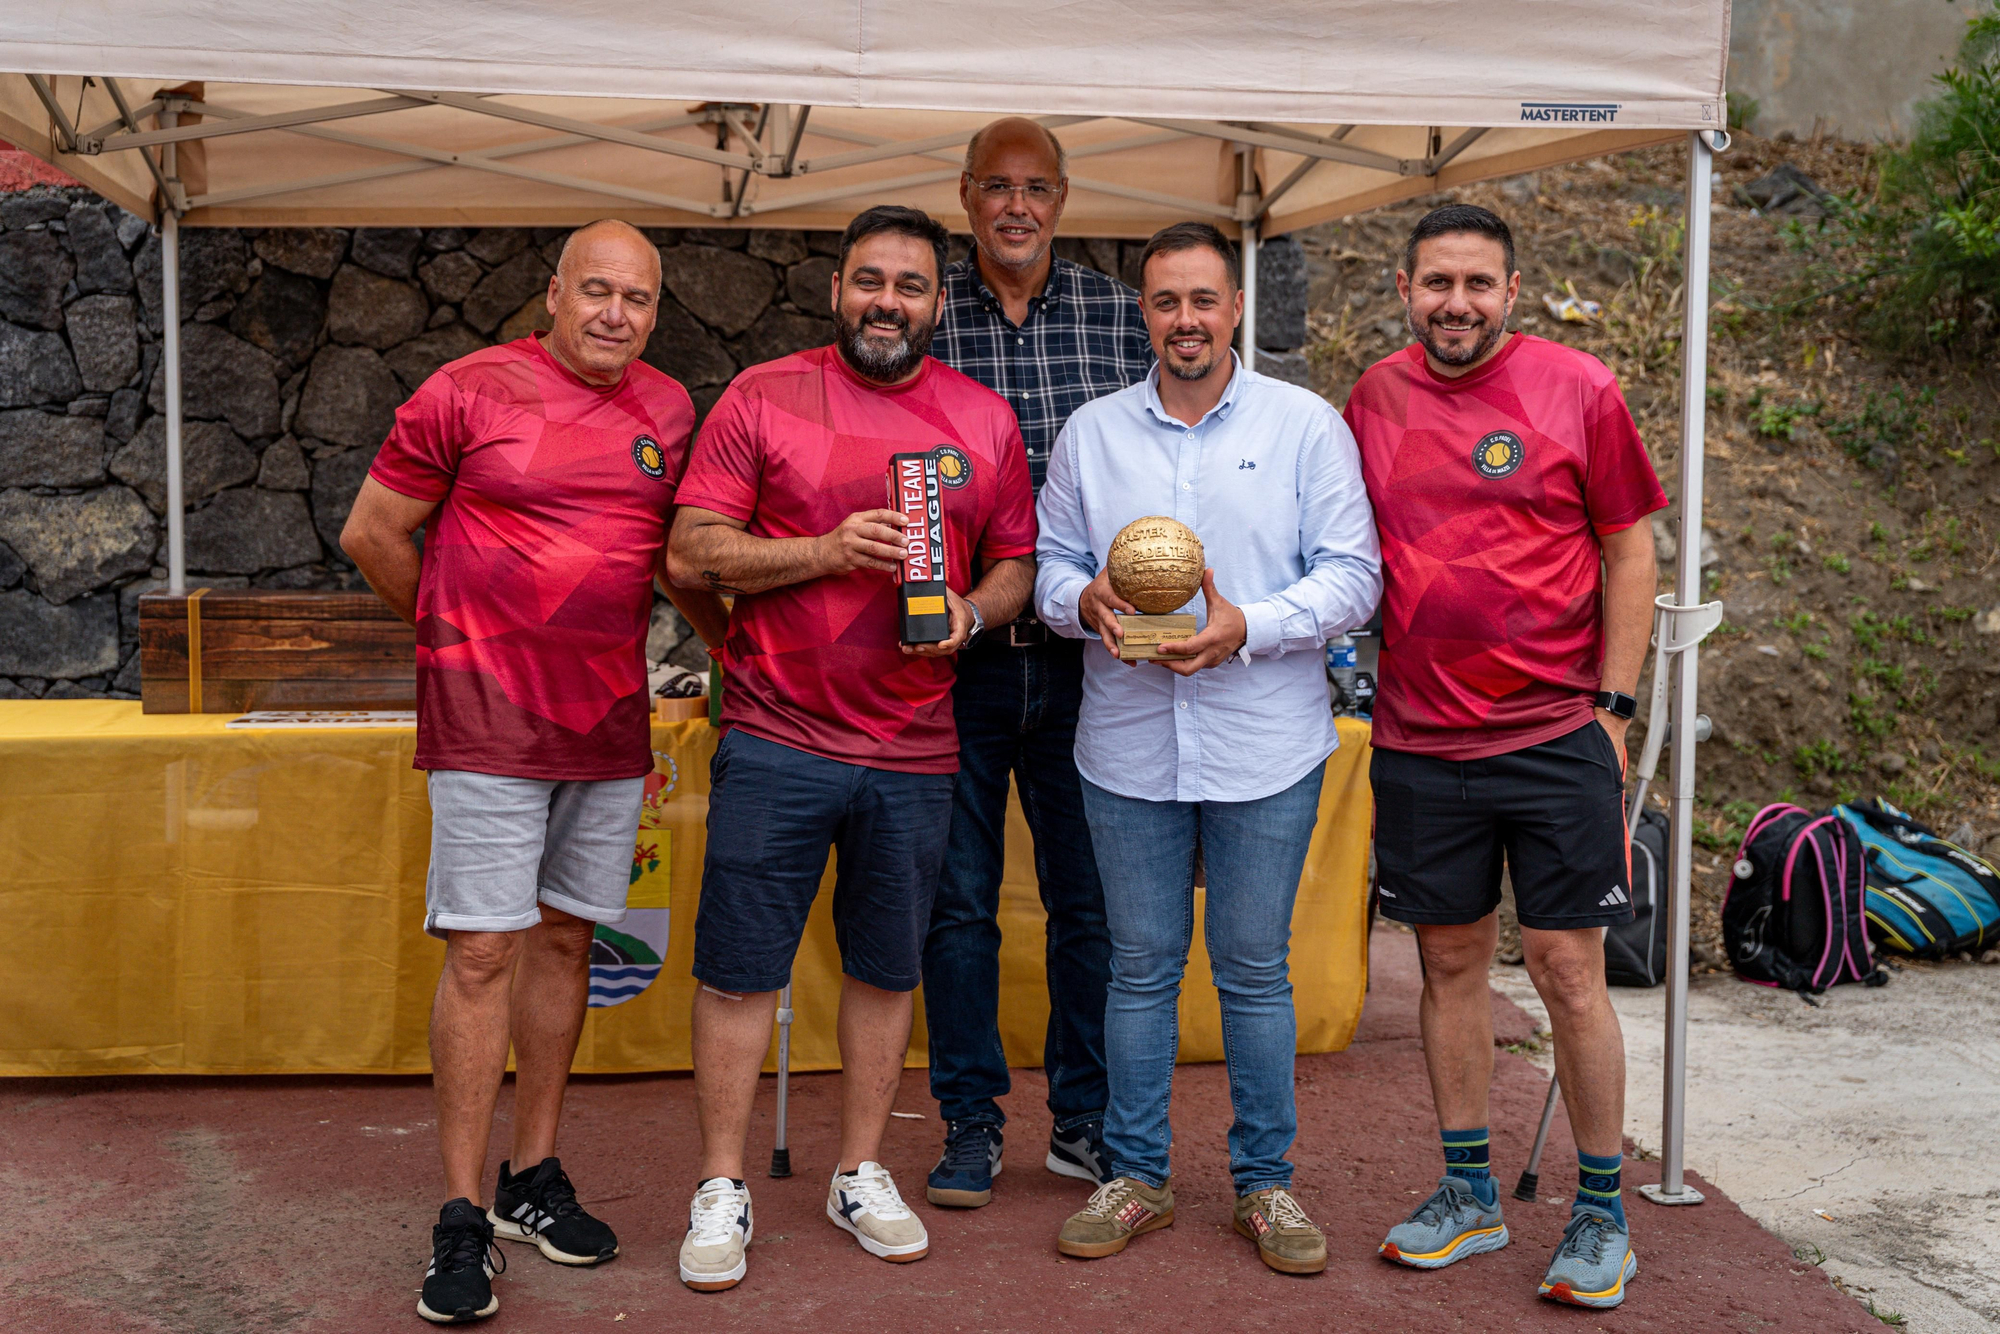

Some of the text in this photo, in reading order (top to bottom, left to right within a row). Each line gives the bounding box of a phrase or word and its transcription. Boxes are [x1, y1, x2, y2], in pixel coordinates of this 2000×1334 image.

[1521, 108, 1618, 122] MASTERTENT
[902, 459, 924, 514] TEAM
[924, 458, 945, 582] LEAGUE
[907, 516, 928, 581] PADEL
[1131, 545, 1198, 561] PADEL TEAM
[1133, 563, 1197, 574] LEAGUE
